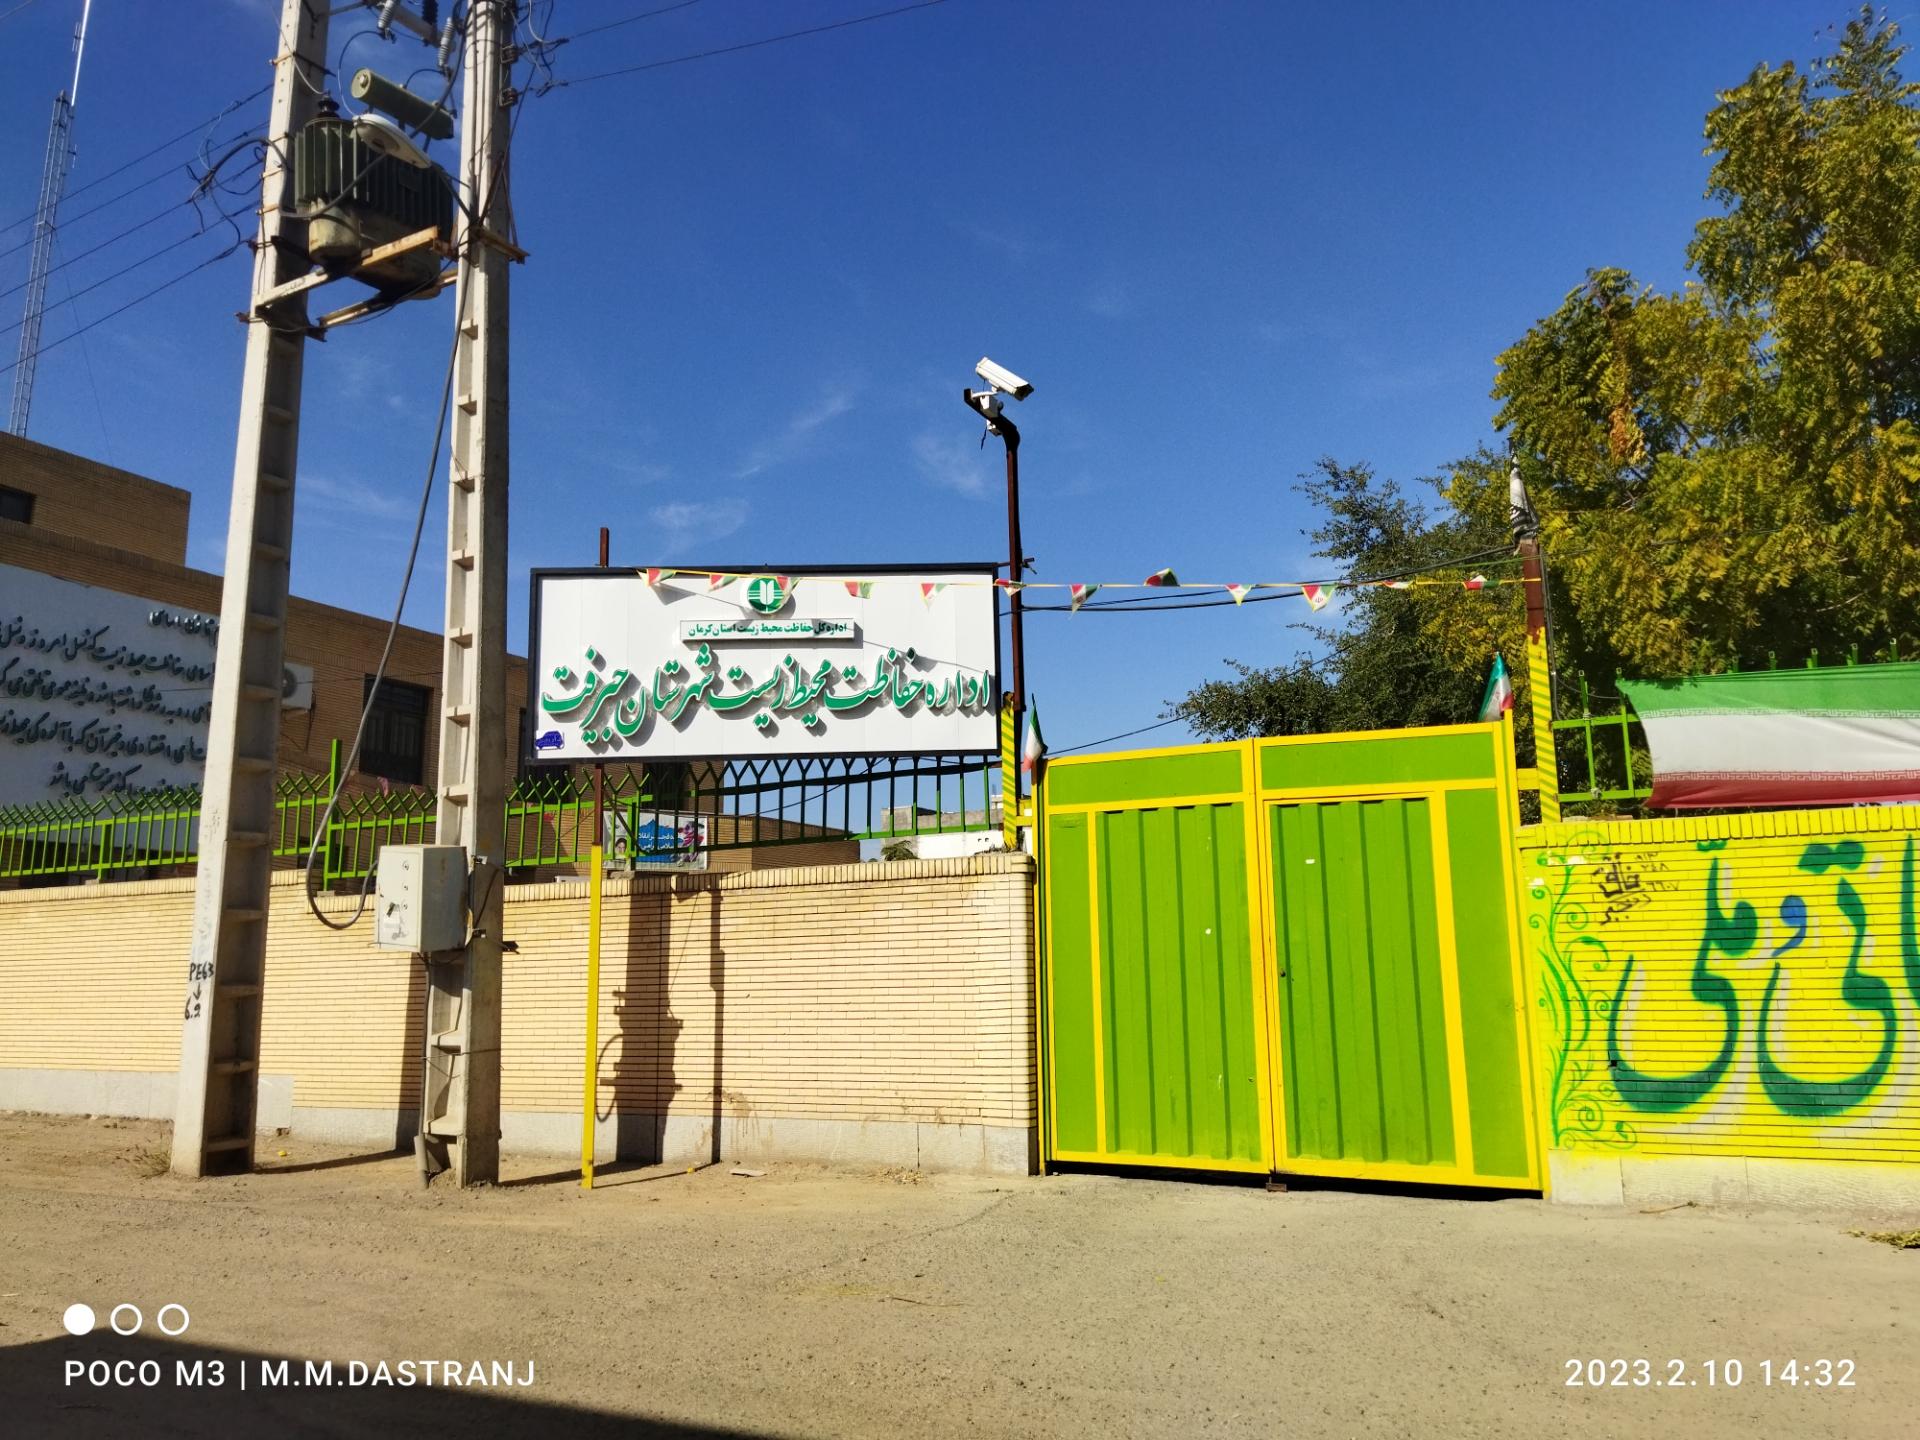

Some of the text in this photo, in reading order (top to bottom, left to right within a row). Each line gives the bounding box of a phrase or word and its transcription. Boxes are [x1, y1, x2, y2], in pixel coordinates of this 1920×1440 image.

[688, 624, 713, 636] کرمان
[736, 624, 760, 636] زیست
[760, 623, 783, 635] محیط
[784, 622, 814, 633] حفاظت
[541, 642, 990, 743] اداره حفاظت محیط زیست شهرستان جیرفت
